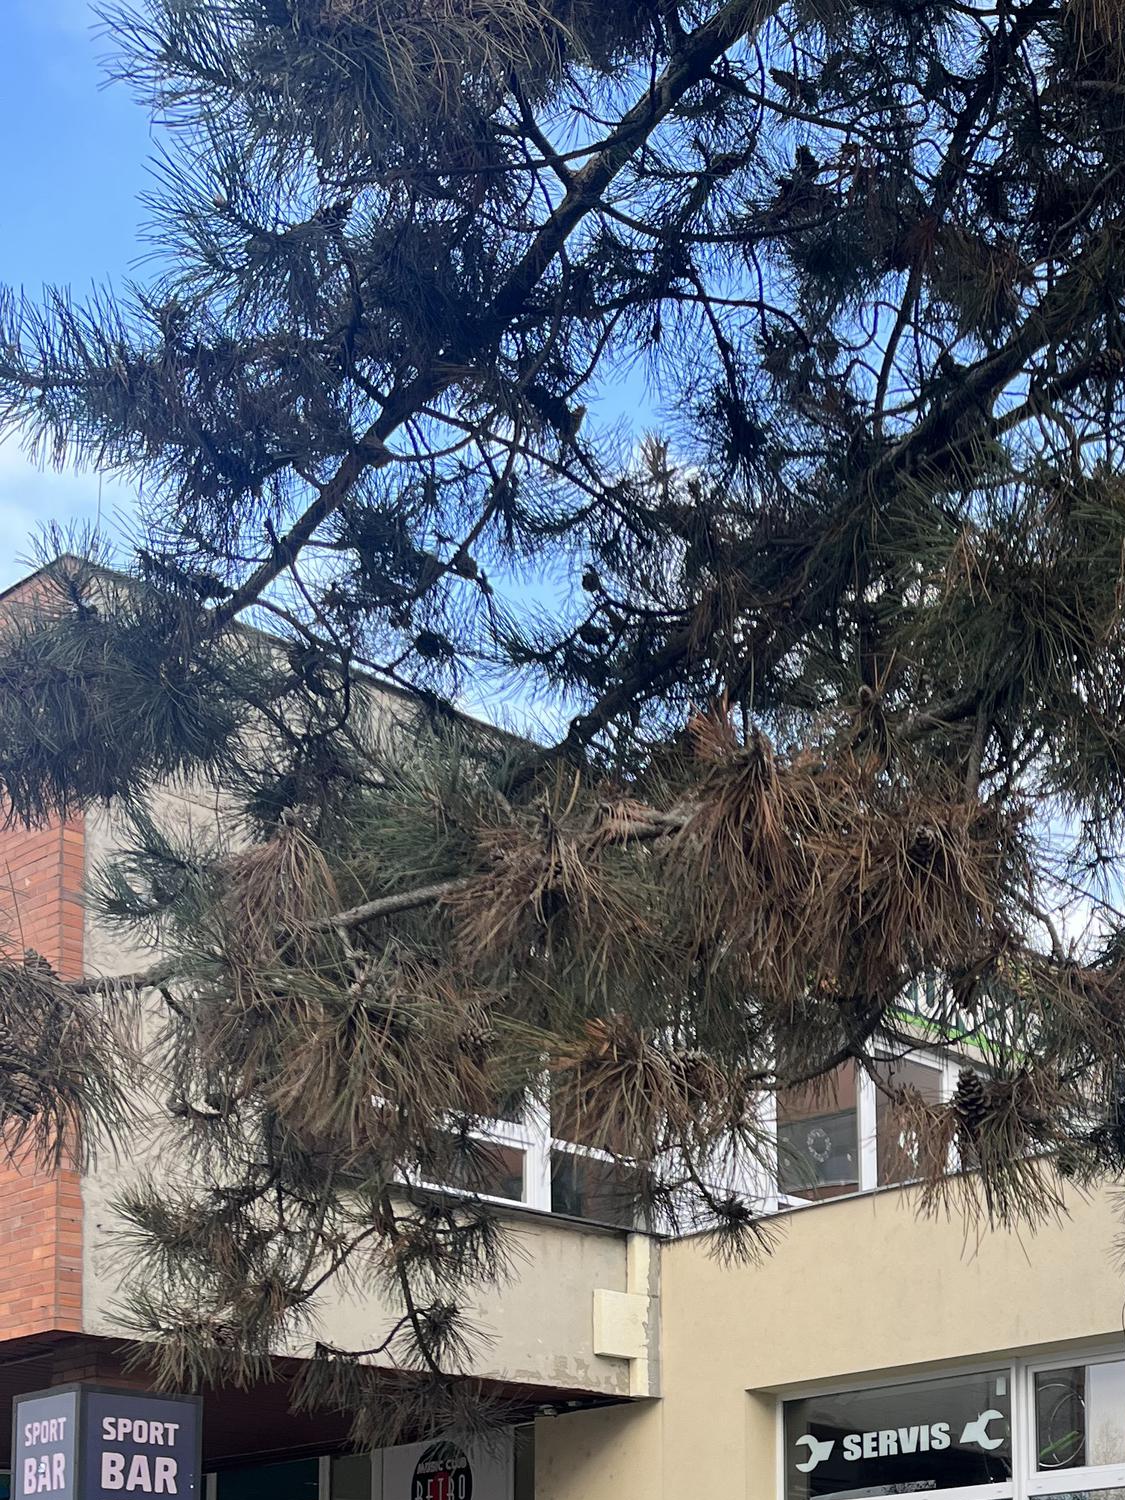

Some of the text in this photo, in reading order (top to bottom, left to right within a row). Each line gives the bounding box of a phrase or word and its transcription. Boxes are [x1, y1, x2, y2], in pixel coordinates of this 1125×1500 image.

[25, 1417, 67, 1447] SPORT
[102, 1416, 179, 1446] SPORT
[843, 1422, 951, 1461] SERVIS
[24, 1453, 65, 1495] BAR
[101, 1452, 178, 1494] BAR
